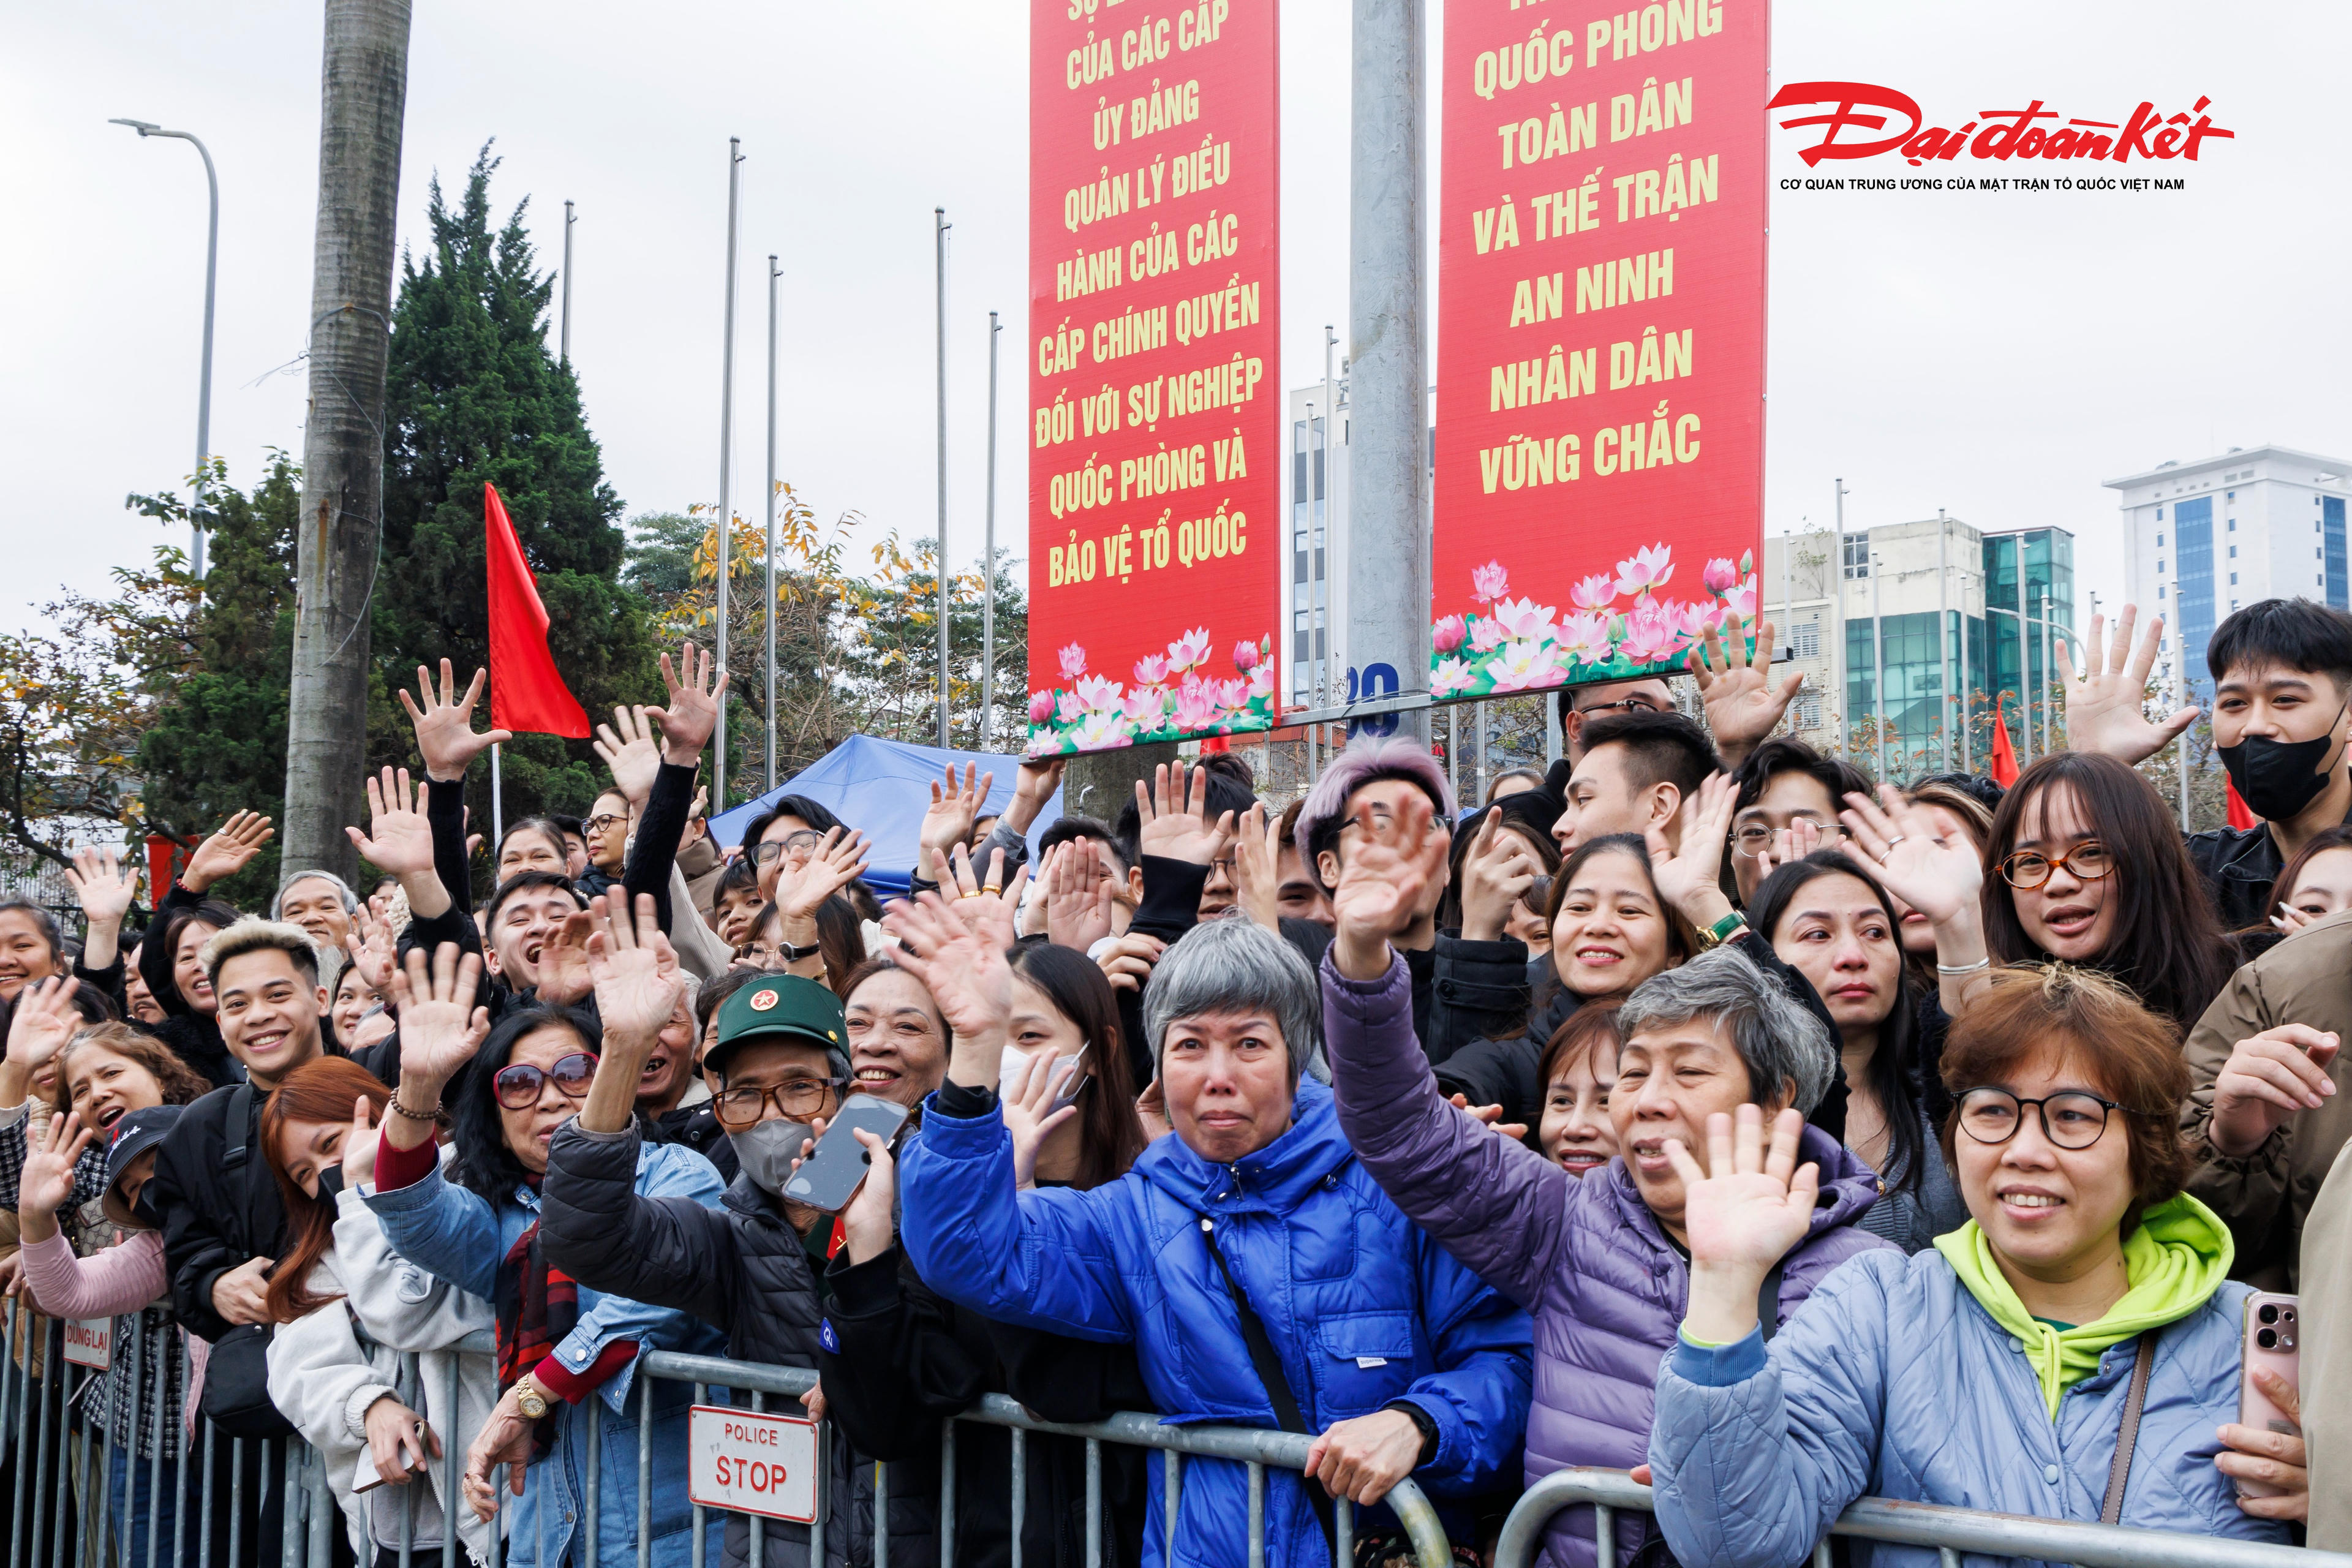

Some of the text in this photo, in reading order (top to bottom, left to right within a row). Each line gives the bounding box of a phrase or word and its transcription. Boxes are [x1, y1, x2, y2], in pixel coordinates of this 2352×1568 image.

[1067, 31, 1114, 90] CỦA
[1121, 15, 1170, 70] CÁC
[1474, 19, 1574, 100] QUỐC
[1094, 78, 1199, 150] ỦY ĐẢNG
[1498, 77, 1692, 169] TOÀN DÂN
[1065, 133, 1230, 233] QUẢN LÝ ĐIỀU
[1473, 153, 1719, 255] VÀ THẾ TRẬN
[1057, 209, 1238, 302] HÀNH CỦA CÁC
[1510, 248, 1673, 327] AN NINH
[1039, 273, 1259, 376] CẤP CHÍNH QUYỀN
[1035, 352, 1262, 448] ĐỐI VỚI SỰ NGHIỆP
[1490, 326, 1692, 412] NHÂN DÂN
[1050, 428, 1246, 519] QUỐC PHÒNG VÀ
[1480, 399, 1700, 494] VỮNG CHẮC
[1050, 499, 1246, 587] BẢO VỆ TỔ QUỐC
[91, 1330, 107, 1355] LẠI
[716, 1455, 786, 1494] STOP
[725, 1423, 777, 1446] POLICE
